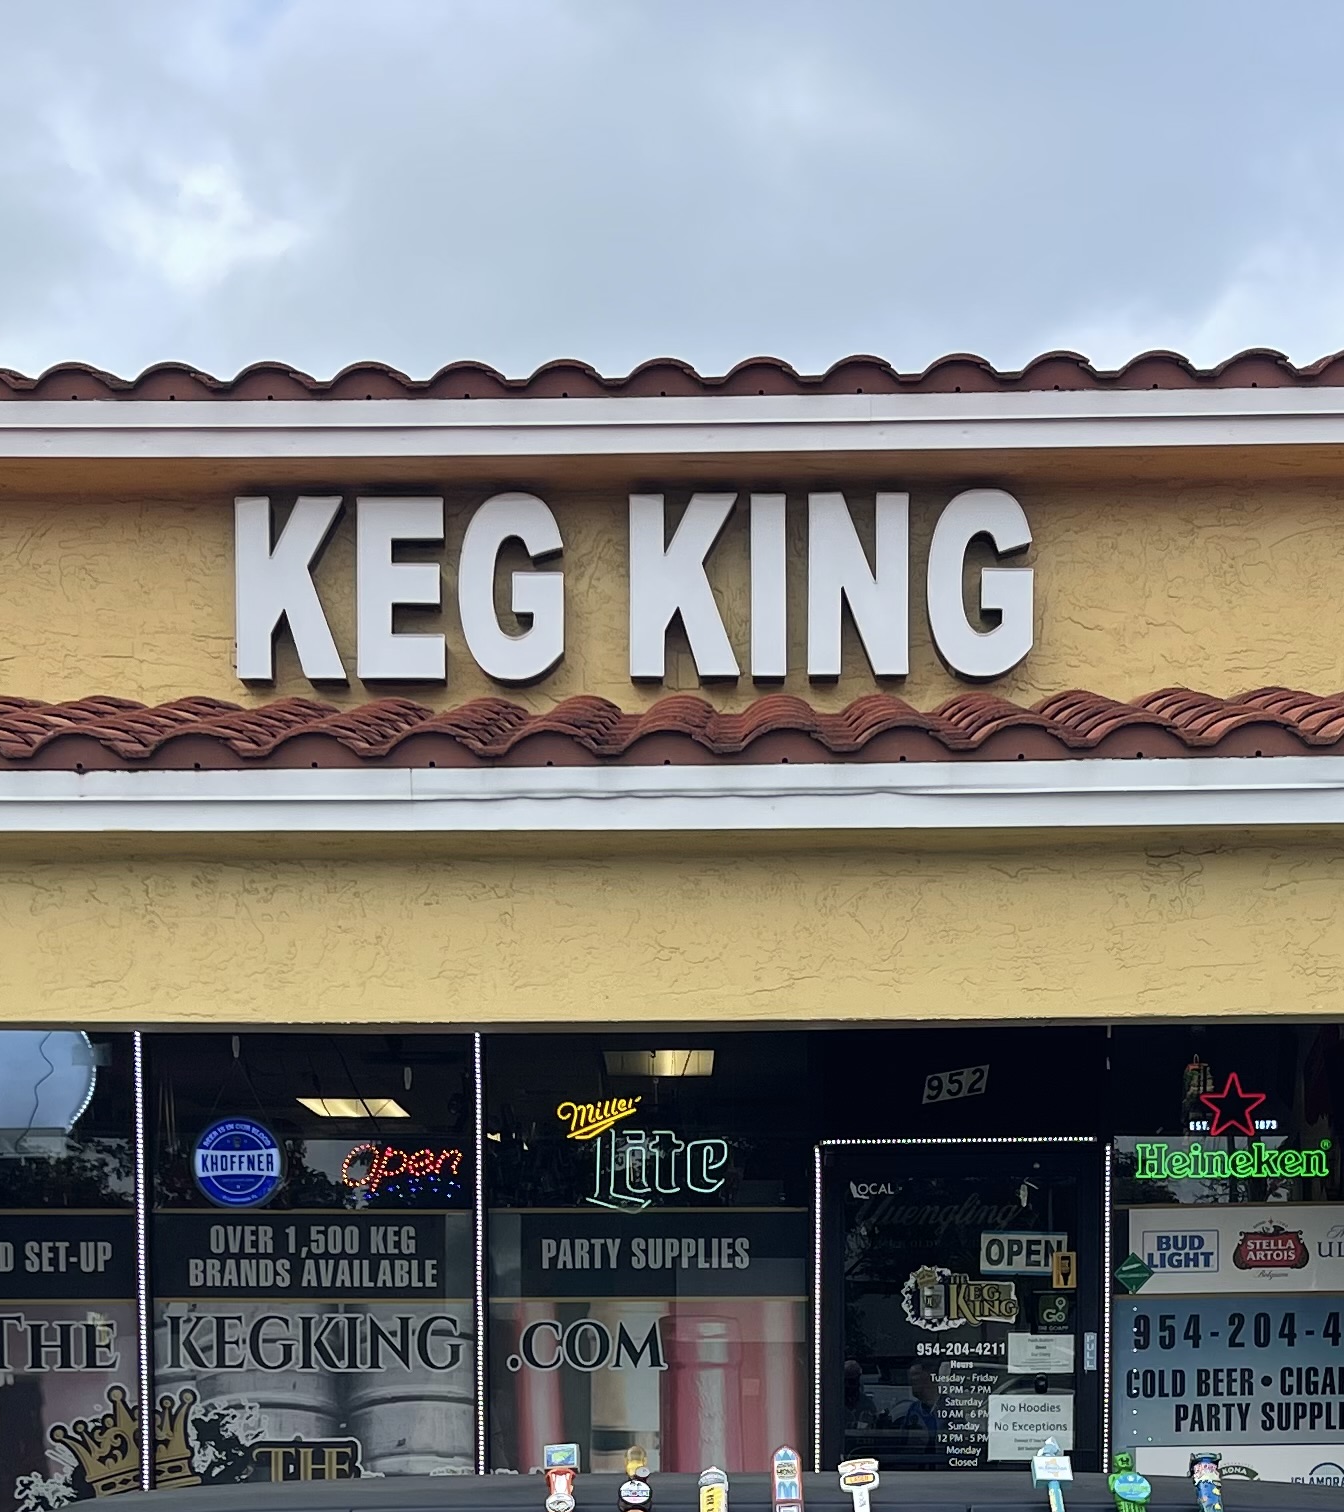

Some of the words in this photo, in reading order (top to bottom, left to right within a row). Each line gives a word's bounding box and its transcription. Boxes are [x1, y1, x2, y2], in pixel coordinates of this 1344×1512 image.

[234, 491, 566, 684] KEG
[628, 488, 1035, 682] KING
[924, 1066, 986, 1102] 952
[557, 1096, 642, 1133] Miller
[1255, 1120, 1278, 1130] 1873
[201, 1153, 274, 1173] KHOFFNER
[342, 1144, 463, 1192] Open
[1135, 1142, 1329, 1179] Heineken
[586, 1128, 728, 1213] Lite
[210, 1225, 276, 1254] OVER
[284, 1225, 359, 1258] 1,500
[369, 1225, 417, 1255] KEG
[1156, 1235, 1205, 1251] BUD
[1246, 1239, 1296, 1250] STELLA
[24, 1240, 113, 1272] SET-UP
[540, 1238, 622, 1270] PARTY
[630, 1237, 751, 1270] SUPPLIES
[985, 1238, 1063, 1267] OPEN
[1147, 1251, 1214, 1269] LIGHT
[1246, 1250, 1296, 1261] ARTOIS
[188, 1260, 292, 1289] BRANDS
[301, 1258, 439, 1288] AVAILABLE
[161, 1311, 465, 1374] KEGKING
[506, 1317, 669, 1373] .COM
[916, 1342, 1006, 1356] 954-204-4211
[1086, 1333, 1095, 1369] PULL
[950, 1360, 974, 1369] Hours
[930, 1374, 965, 1384] Tuesday
[971, 1374, 999, 1384] Friday
[1126, 1368, 1186, 1399] COLD
[1196, 1367, 1254, 1397] BEER
[937, 1385, 947, 1394] 12
[947, 1385, 963, 1394] PM
[970, 1385, 975, 1394] 7
[978, 1385, 991, 1394] PM
[945, 1398, 983, 1407] Saturday
[1000, 1403, 1016, 1412] No
[1018, 1403, 1061, 1412] Hoodies
[937, 1410, 947, 1418] 10
[948, 1410, 963, 1418] AM
[970, 1410, 975, 1418] 6
[1174, 1402, 1251, 1432] PARTY
[948, 1422, 980, 1431] Sunday
[994, 1421, 1009, 1431] No
[1012, 1421, 1068, 1433] Exceptions
[937, 1434, 947, 1443] 12
[947, 1434, 963, 1443] PM
[970, 1434, 975, 1443] 5
[946, 1446, 982, 1456] Monday
[251, 1446, 355, 1483] THE
[948, 1458, 978, 1467] Closed
[1221, 1467, 1248, 1476] KONA
